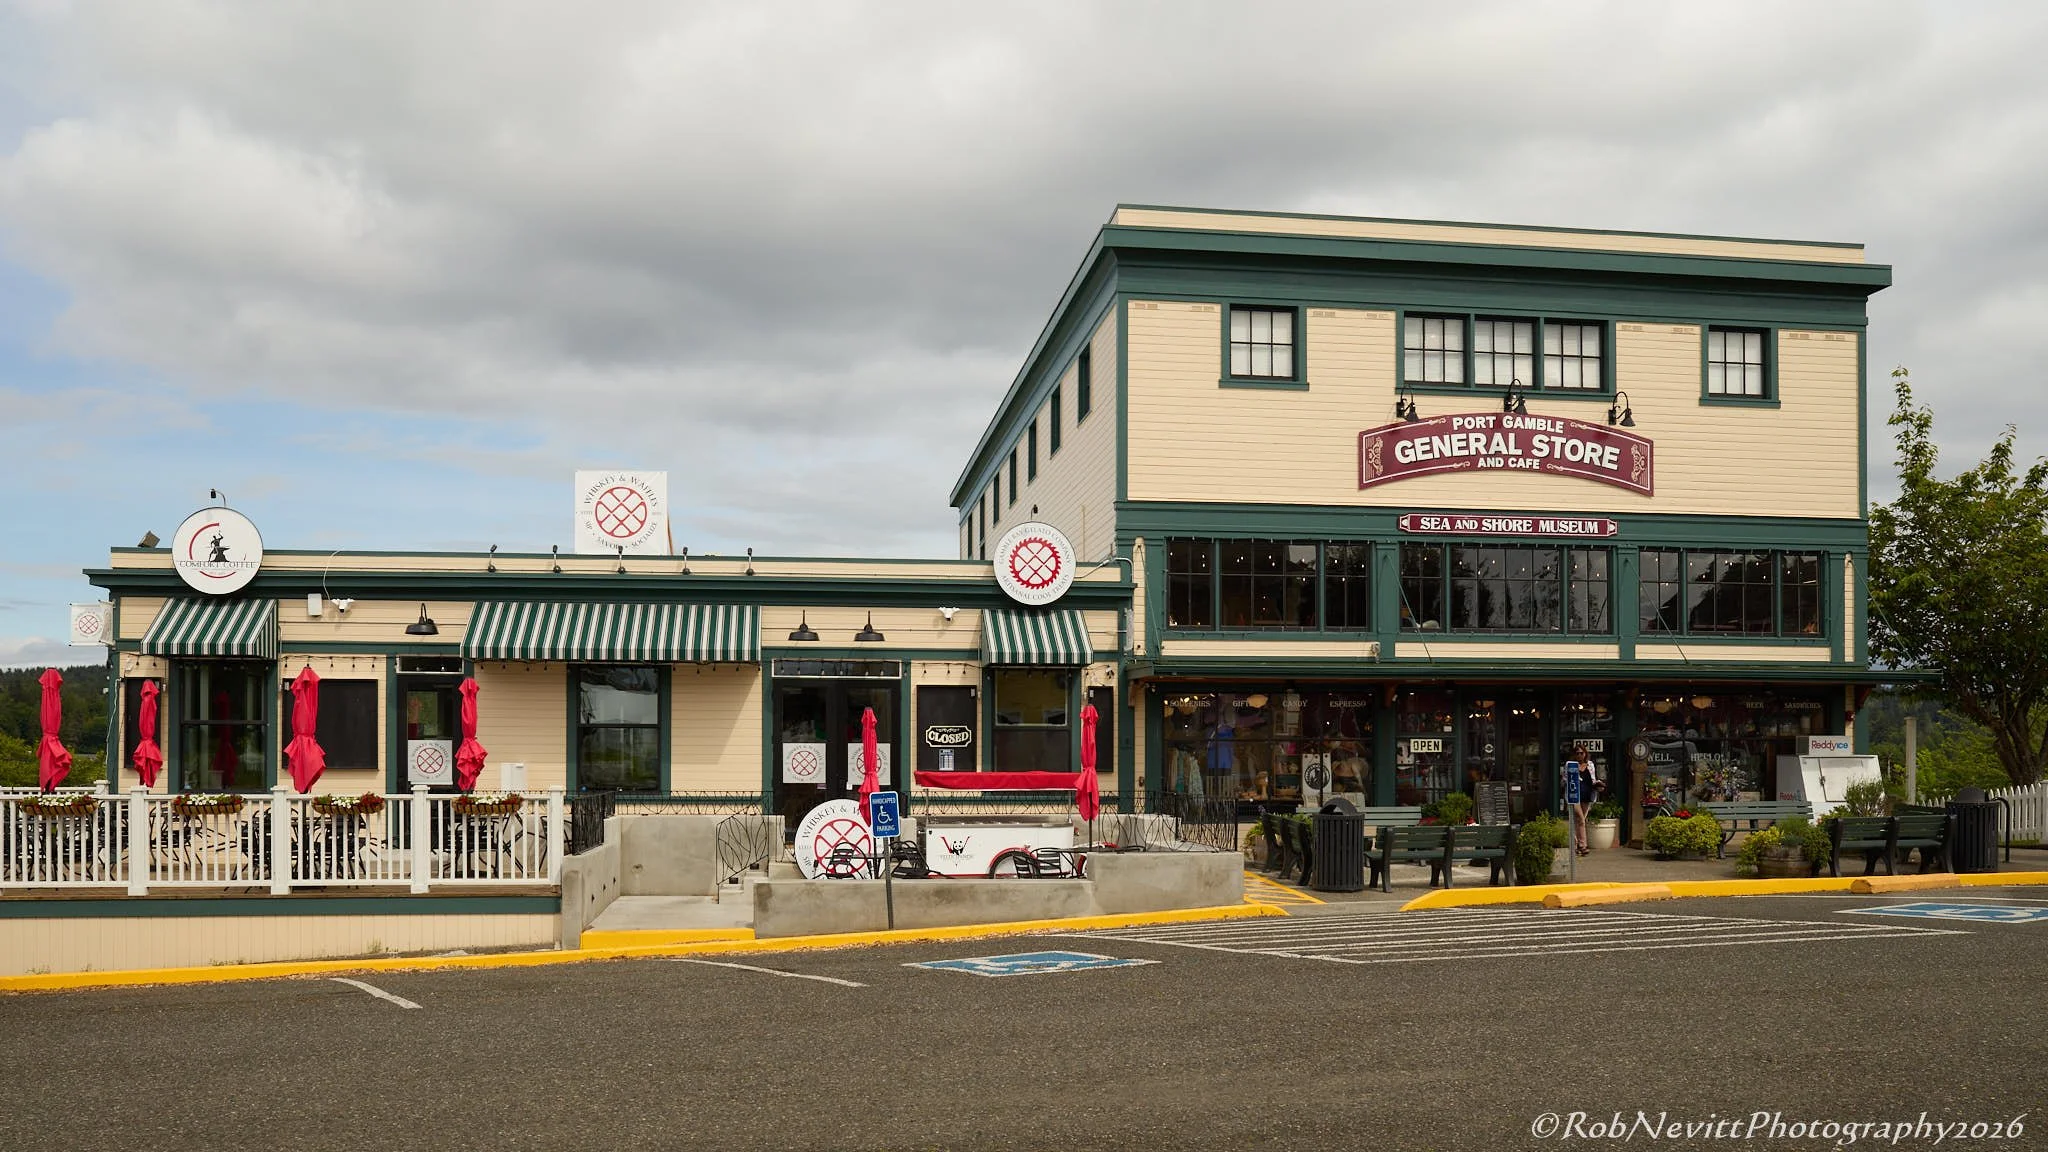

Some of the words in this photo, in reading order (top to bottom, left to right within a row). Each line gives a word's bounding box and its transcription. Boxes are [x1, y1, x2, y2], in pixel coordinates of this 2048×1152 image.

[1453, 416, 1496, 431] PORT
[1502, 415, 1564, 434] GAMBLE
[1394, 432, 1522, 465] GENERAL
[1532, 434, 1620, 470] STORE
[1477, 457, 1504, 469] AND
[1507, 457, 1540, 470] CAFE
[584, 476, 615, 504] WHISKEY
[631, 476, 658, 507] WAFFLES
[1420, 517, 1451, 530] SEA
[1454, 518, 1478, 530] AND
[1482, 517, 1532, 532] SHORE
[1538, 519, 1599, 534] MUSEUM
[598, 537, 619, 549] SAVO
[179, 560, 219, 568] COMFORT
[223, 561, 256, 569] COFFEE
[1282, 700, 1308, 708] CANDY
[928, 730, 969, 743] CLOSED
[1413, 740, 1441, 751] OPEN
[802, 805, 836, 838] WHISKEY
